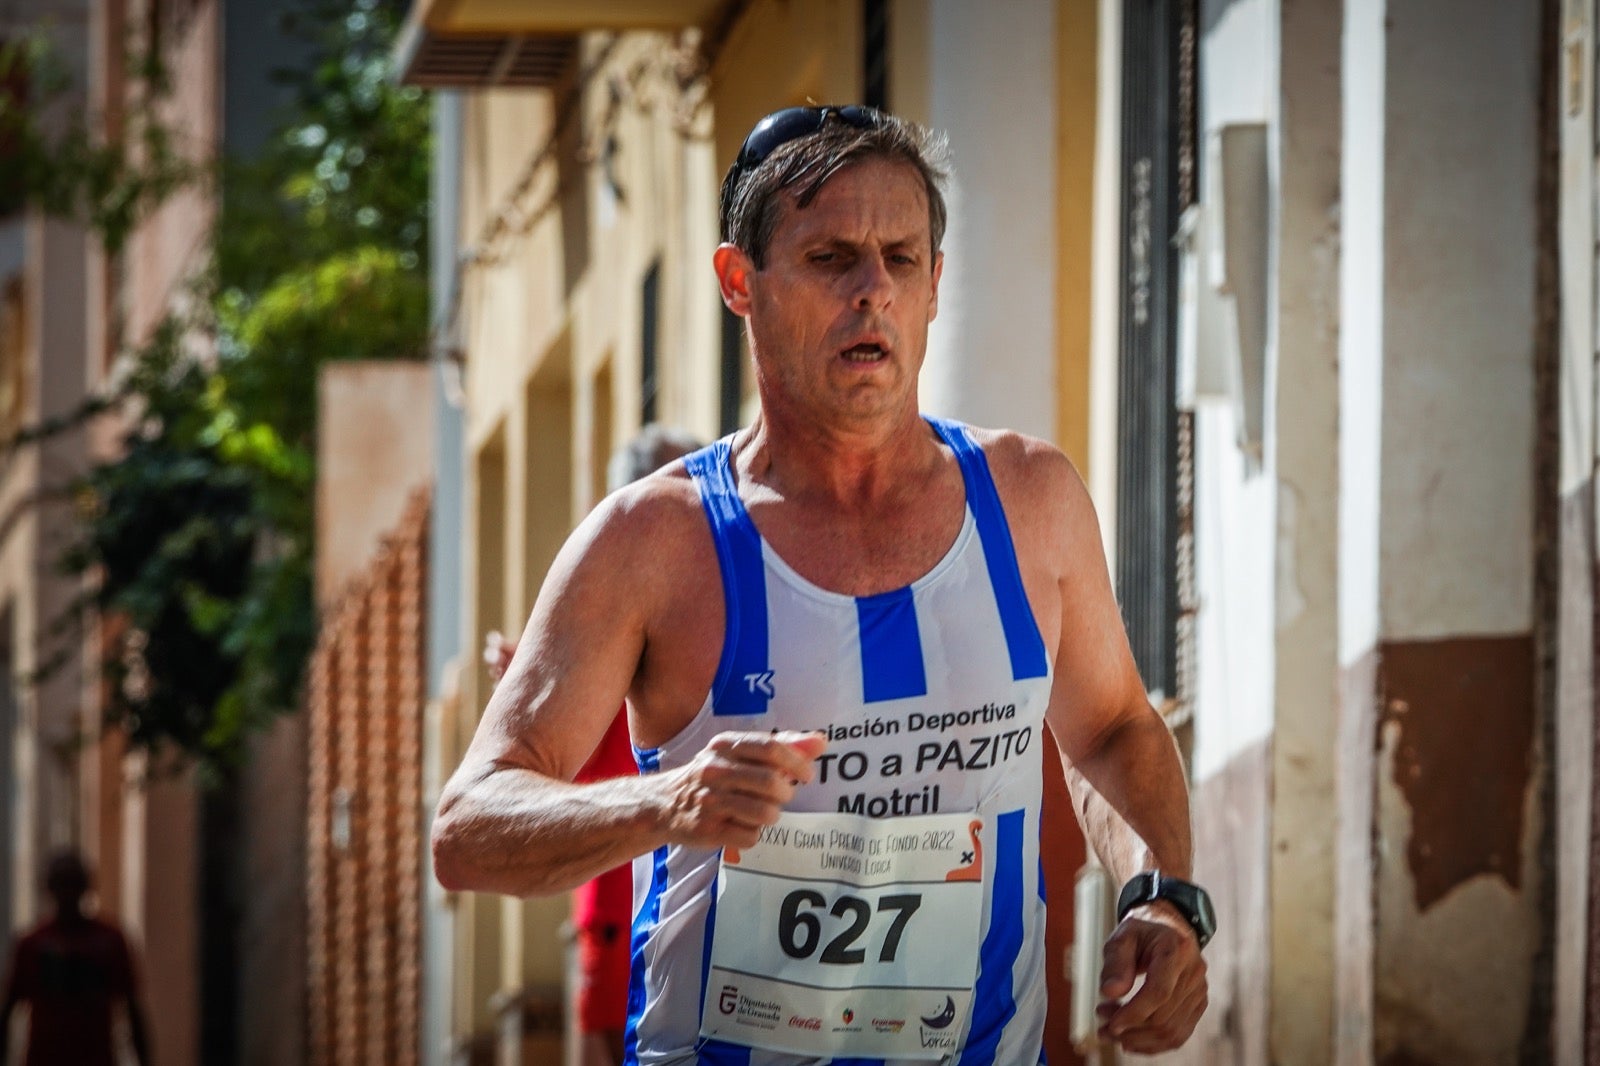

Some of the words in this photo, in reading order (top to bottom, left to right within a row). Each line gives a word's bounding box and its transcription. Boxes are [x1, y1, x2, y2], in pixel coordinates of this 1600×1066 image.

[769, 717, 900, 742] iación
[908, 703, 1016, 733] Deportiva
[880, 753, 902, 777] a
[915, 726, 1032, 772] PAZITO
[837, 785, 940, 818] Motril
[922, 830, 955, 851] 2022
[779, 889, 922, 964] 627
